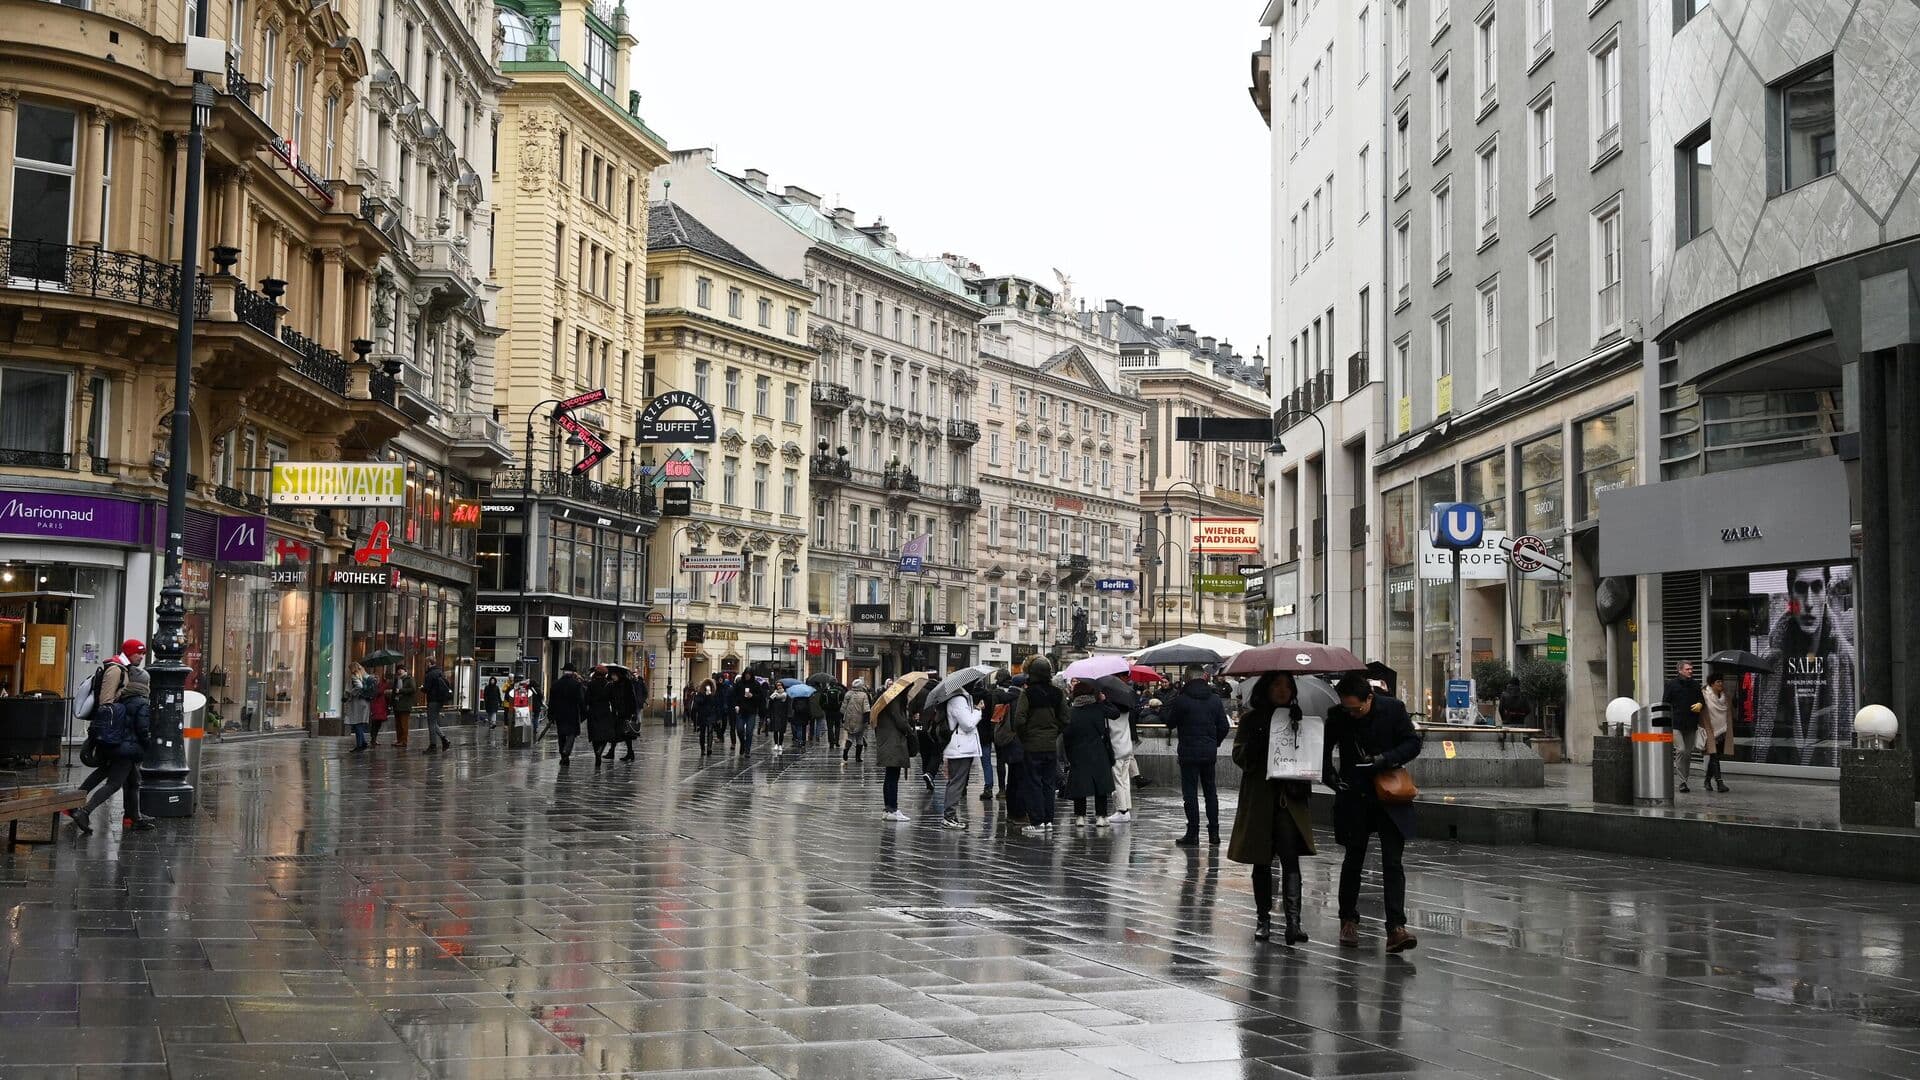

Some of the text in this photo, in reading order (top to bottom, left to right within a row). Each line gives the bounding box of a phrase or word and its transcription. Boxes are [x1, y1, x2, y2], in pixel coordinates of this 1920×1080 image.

[643, 394, 712, 429] TRZESNIEWSKI
[655, 422, 697, 432] BUFFET
[280, 466, 395, 495] STURMAYR
[0, 499, 93, 521] Marionnaud
[37, 521, 63, 530] PARIS
[1204, 527, 1245, 535] WIENER
[1448, 511, 1476, 541] U
[1720, 525, 1762, 542] ZARA
[901, 556, 918, 566] LPE
[333, 571, 387, 585] APOTHEKE
[1102, 581, 1129, 589] Berlitz
[1788, 656, 1824, 674] SALE
